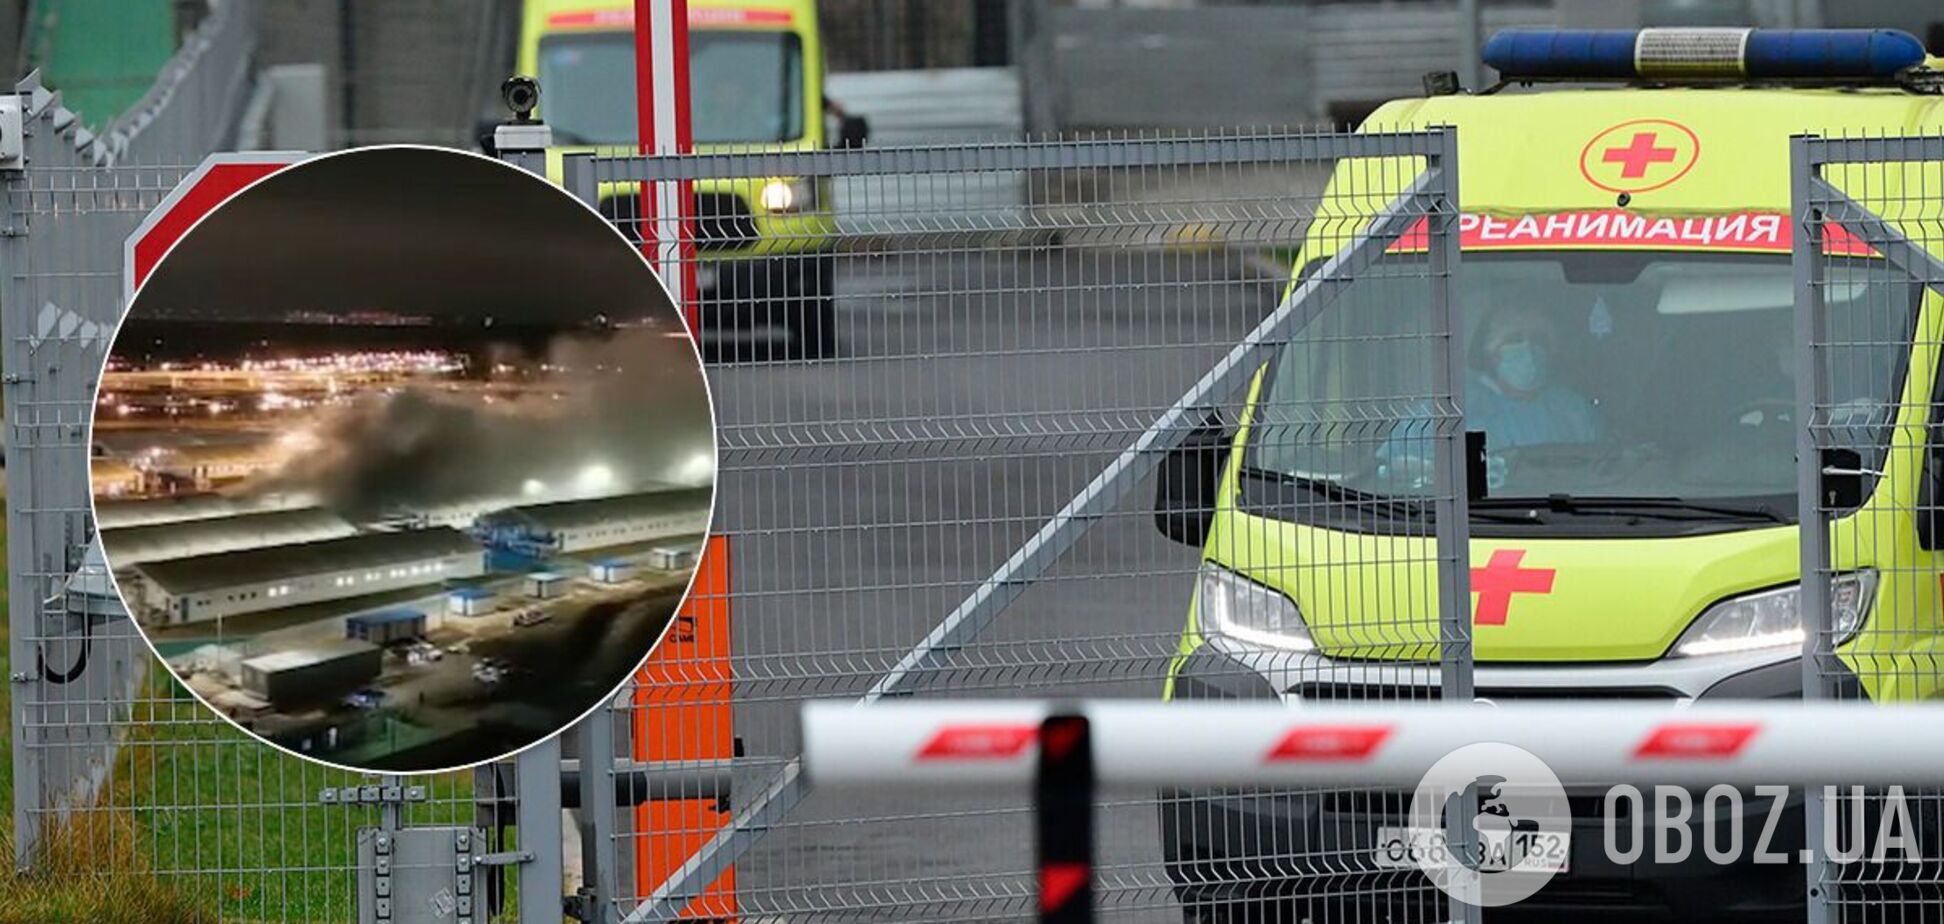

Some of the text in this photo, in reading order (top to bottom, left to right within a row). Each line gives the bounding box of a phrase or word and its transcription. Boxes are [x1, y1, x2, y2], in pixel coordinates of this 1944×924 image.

[1459, 212, 1781, 245] РЕАНИМАЦИЯ
[1516, 833, 1561, 859] 152
[1523, 858, 1547, 868] RUS
